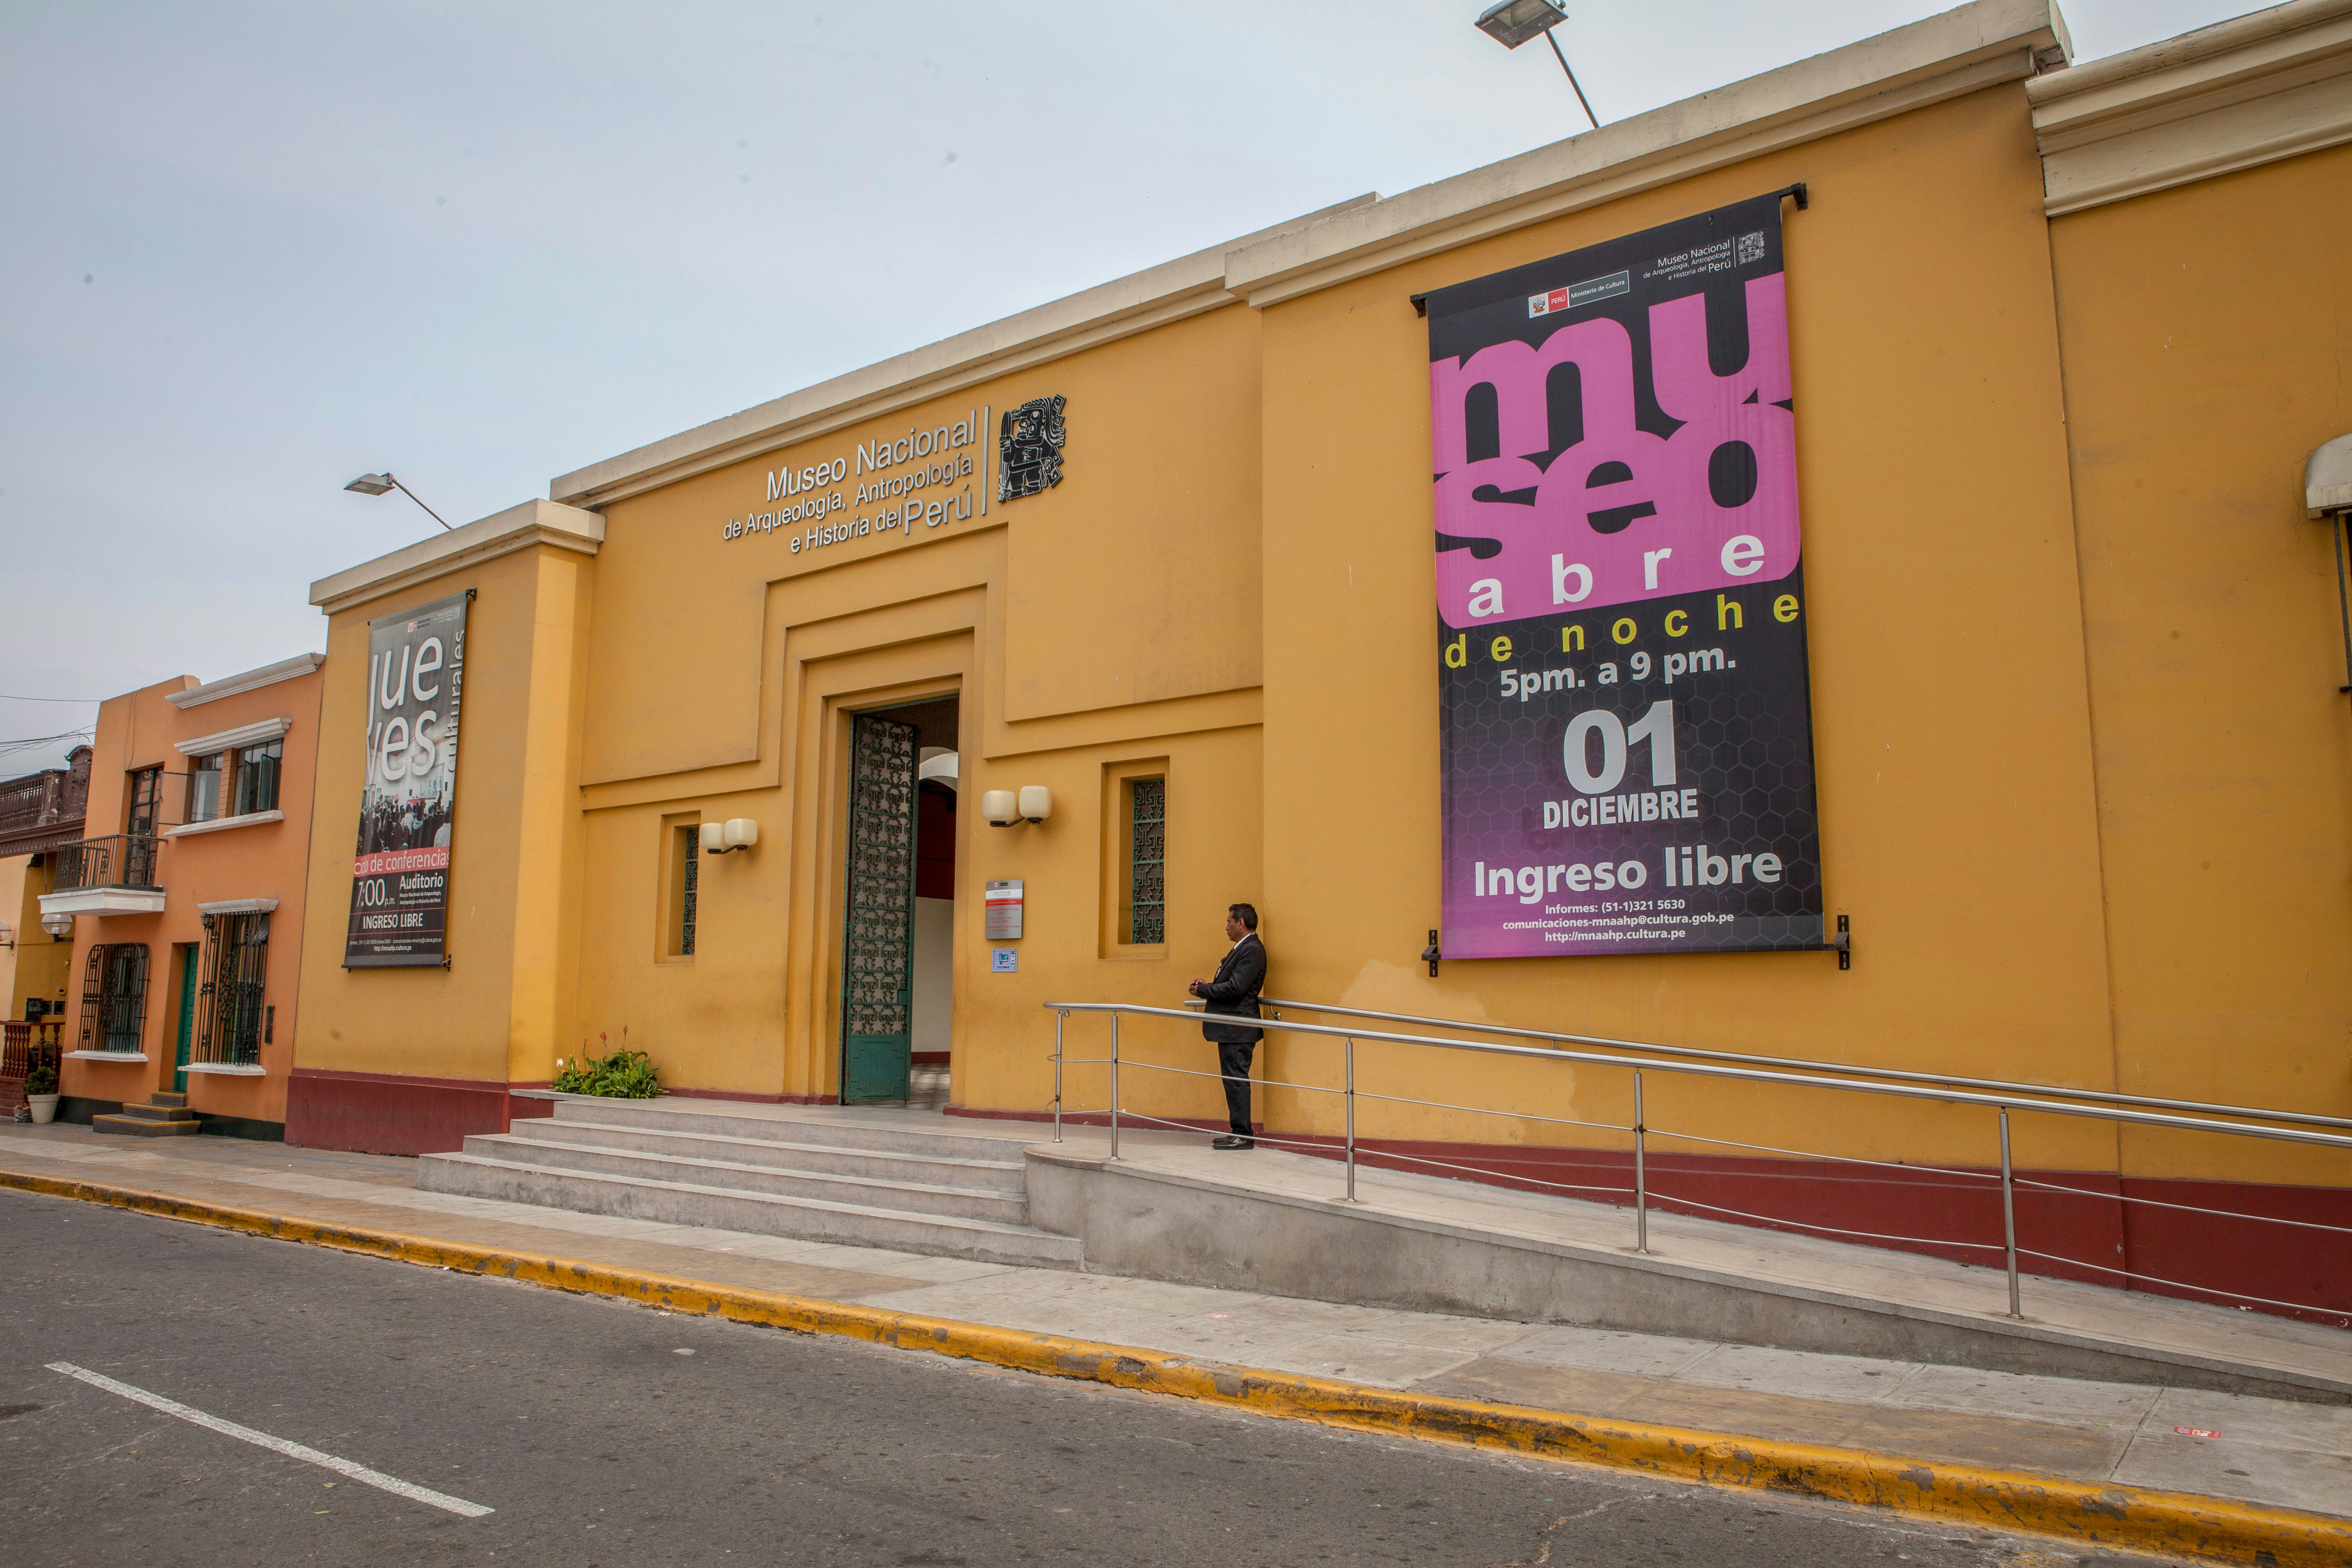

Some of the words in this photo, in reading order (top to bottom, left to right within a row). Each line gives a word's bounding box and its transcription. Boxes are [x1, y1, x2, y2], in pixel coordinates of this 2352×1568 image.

[1652, 262, 1689, 276] Arqueología,
[1691, 250, 1731, 265] Antropología
[1658, 254, 1688, 268] Museo
[1691, 239, 1730, 258] Nacional
[1673, 269, 1696, 279] Historia
[1708, 258, 1731, 273] Perú
[1551, 294, 1565, 304] PERÚ
[1571, 288, 1597, 299] Ministerio
[1606, 280, 1625, 289] Cultura
[1430, 271, 1793, 474] mu
[767, 457, 846, 501] Museo
[857, 409, 975, 476] Nacional
[723, 519, 741, 540] de
[745, 490, 846, 534] Arqueología,
[855, 453, 972, 506] Antropología
[791, 537, 800, 553] e
[806, 515, 870, 550] Historia
[875, 504, 902, 531] del
[905, 484, 971, 534] Perú
[1468, 535, 1765, 617] abre
[1445, 634, 1512, 669] de
[1562, 594, 1799, 653] noche
[1500, 666, 1586, 701] 5pm.
[1598, 661, 1618, 685] a
[1630, 651, 1651, 680] 9
[1664, 647, 1736, 684] pm.
[445, 630, 465, 772] culturales
[367, 710, 437, 785] ves
[1563, 699, 1677, 795] 01
[1543, 789, 1699, 829] DICIEMBRE
[370, 854, 383, 872] de
[385, 848, 450, 871] conferencias
[1474, 858, 1647, 904] Ingreso
[1664, 844, 1782, 887] libre
[357, 878, 386, 907] 7:00
[385, 897, 396, 907] p.m.
[400, 872, 444, 890] Auditorio
[363, 914, 398, 929] INGRESO
[401, 913, 424, 928] LIBRE
[1503, 913, 1734, 930] comunicaciones-mnaahp@cultura.gob.pe
[1545, 904, 1598, 914] Informes:
[1601, 900, 1653, 914] (51-1)321
[1657, 899, 1685, 910] 5630
[1545, 929, 1686, 942] http://mnaahp.cultura.pe
